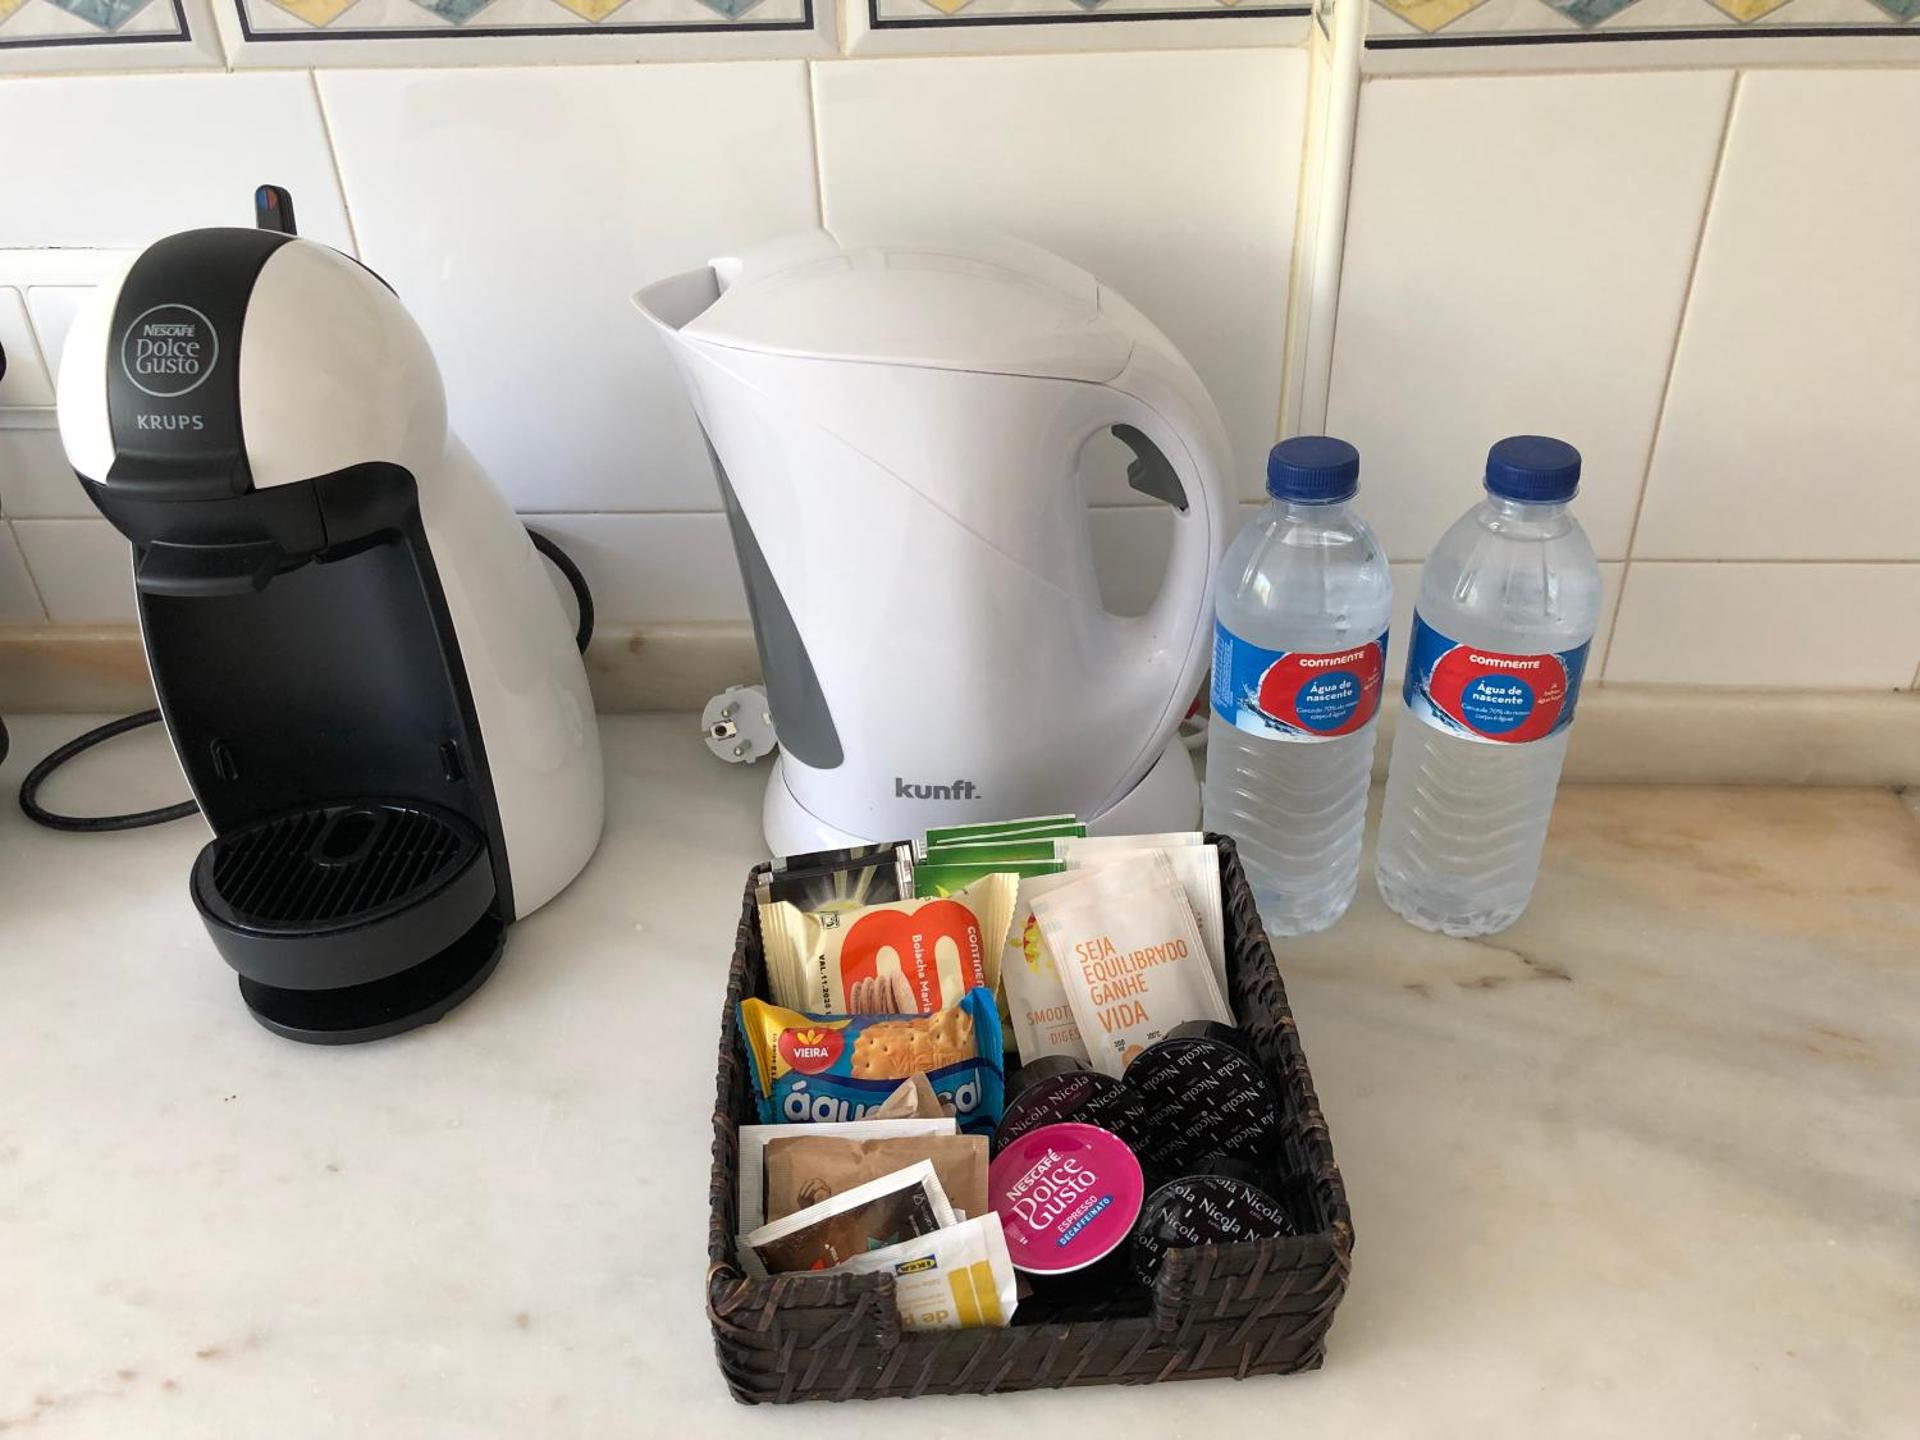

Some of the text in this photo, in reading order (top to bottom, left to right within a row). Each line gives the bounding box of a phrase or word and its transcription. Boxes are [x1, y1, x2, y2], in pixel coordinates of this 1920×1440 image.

[136, 338, 200, 357] Dolce
[136, 356, 200, 374] Gusto
[137, 415, 204, 430] KRUPS
[1299, 651, 1365, 668] CONTINENTE
[1469, 654, 1541, 669] CONTINENTE
[1306, 689, 1353, 702] nascente
[1310, 680, 1352, 698] Água de
[1472, 691, 1523, 705] nascente
[1477, 679, 1505, 695] Água
[1508, 686, 1522, 696] de
[967, 926, 986, 988] CONTINEN
[1075, 936, 1117, 964] SEJA
[1082, 939, 1189, 985] EQUILIBRADO
[912, 934, 931, 1013] Bolacha Maria
[1090, 973, 1149, 1006] GANHE
[1026, 1005, 1074, 1026] SMOOT
[1096, 1000, 1150, 1033] VIDA
[1050, 1029, 1082, 1046] DIGES
[793, 1047, 828, 1058] VIEIRA
[1142, 1043, 1216, 1091] Nicola Nicola
[1086, 1083, 1128, 1113] Nicola
[1181, 1075, 1220, 1102] Nicola
[1221, 1086, 1260, 1113] Nicola
[1010, 1075, 1090, 1136] Nicola Nicola
[1185, 1111, 1223, 1138] Nicola
[1224, 1122, 1265, 1149] Nicola
[1006, 1148, 1062, 1202] NESCAFÉ
[1012, 1158, 1083, 1220] Dolce
[1028, 1170, 1097, 1230] Gusto
[1057, 1195, 1098, 1233] ESPRESSO
[1240, 1187, 1284, 1225] Nicola
[1058, 1196, 1111, 1245] DECAFFEINATO
[1158, 1207, 1199, 1243] Nicola
[1199, 1197, 1241, 1234] Nicola
